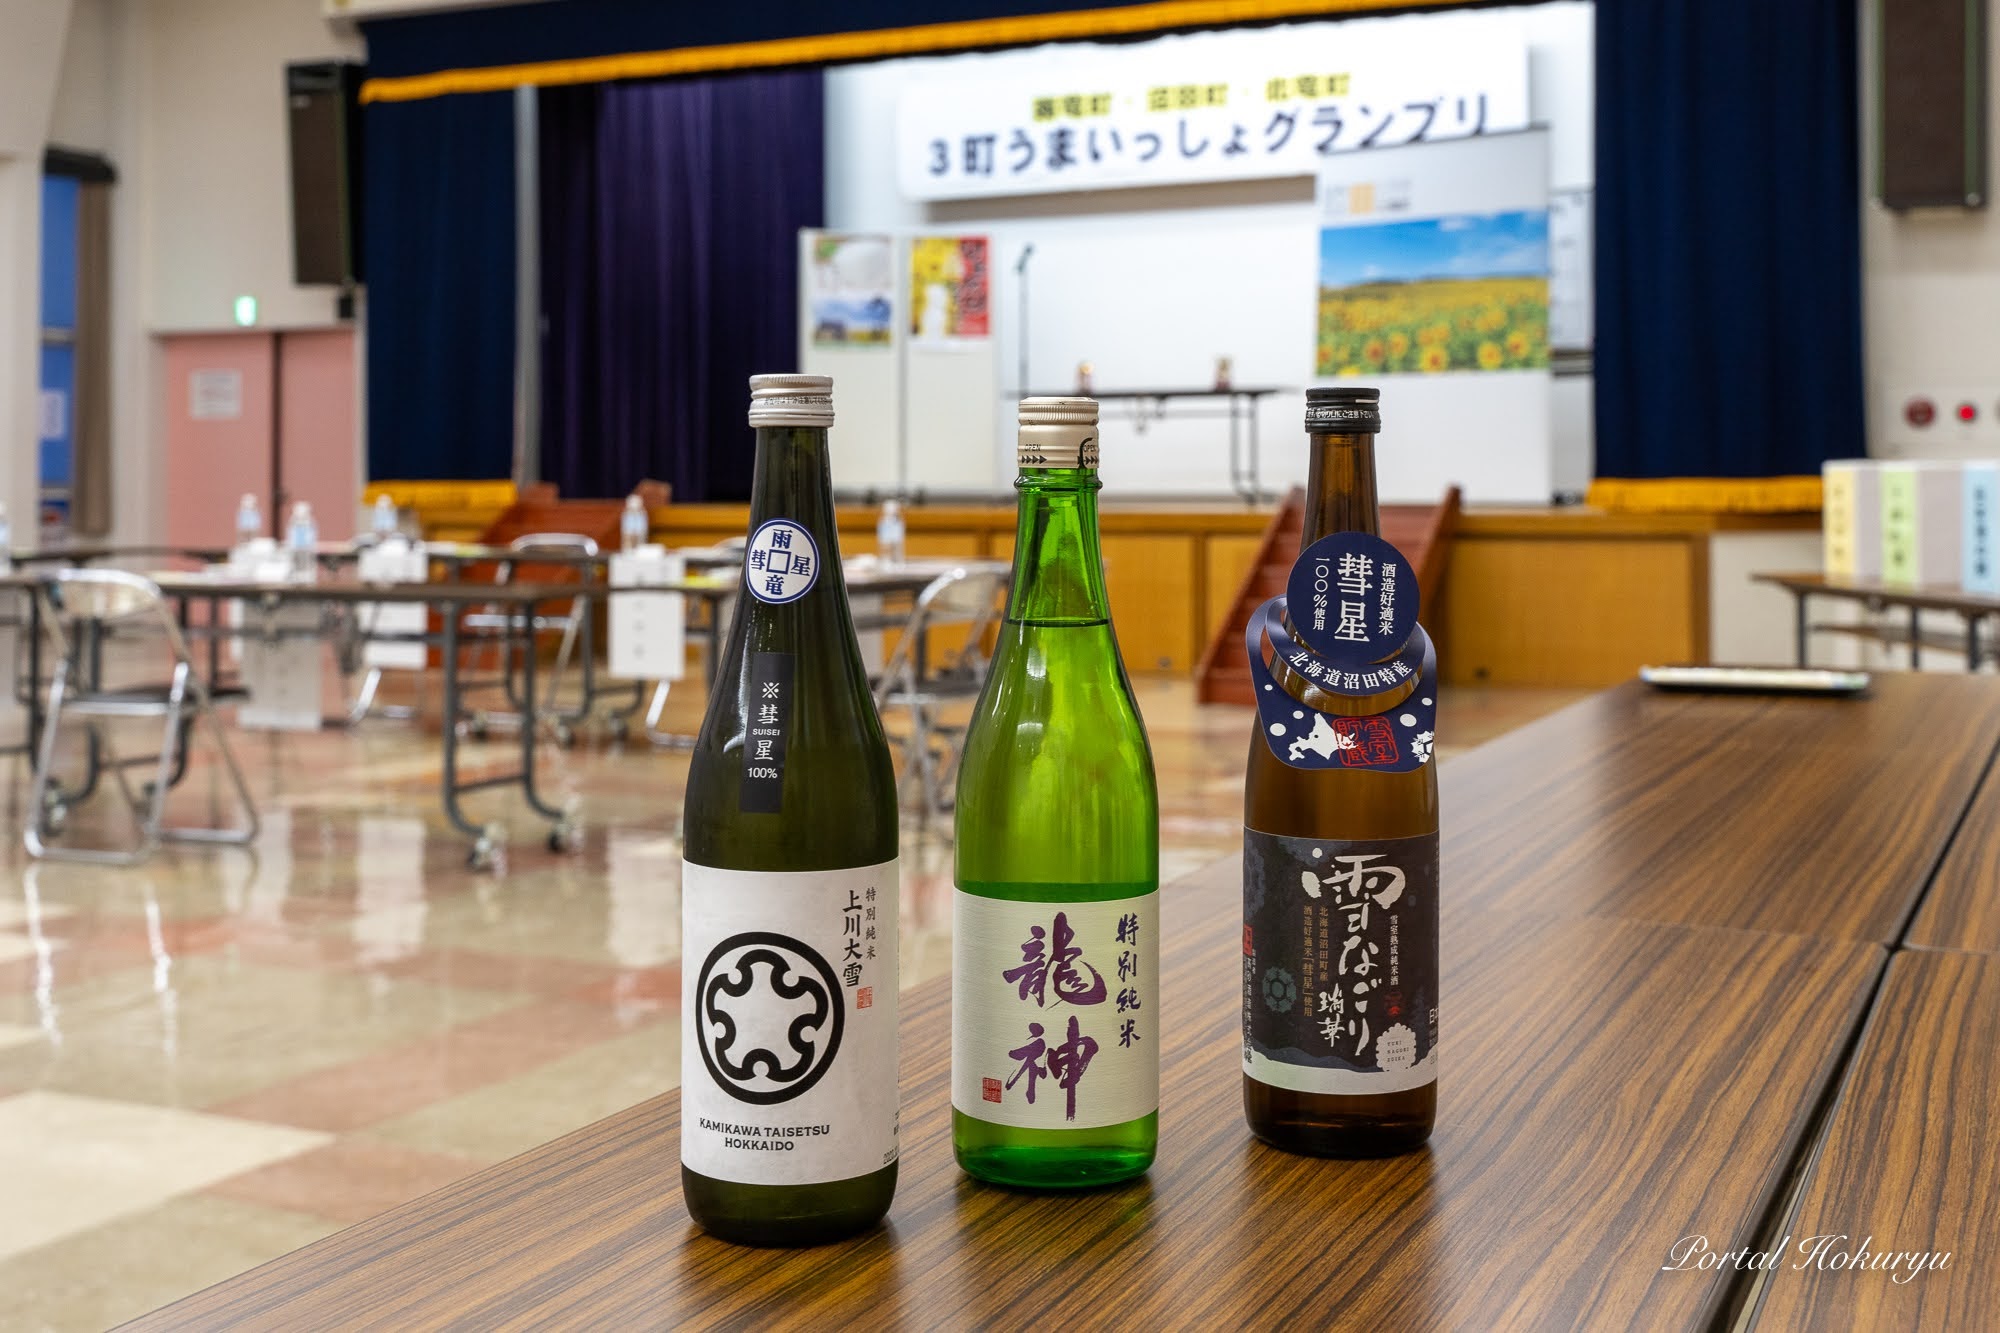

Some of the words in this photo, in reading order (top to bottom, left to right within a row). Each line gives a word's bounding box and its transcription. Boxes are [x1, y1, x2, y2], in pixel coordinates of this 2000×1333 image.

[1024, 443, 1042, 452] OPEN
[1333, 552, 1374, 642] 彗星
[1378, 562, 1397, 635] 酒造好適米
[1289, 650, 1413, 690] 北海道沼田特産
[752, 728, 781, 736] SUISEI
[747, 767, 778, 779] 100%
[842, 889, 863, 988] 上川大雪
[865, 886, 876, 960] 特別純米
[1301, 854, 1406, 1056] 雪なごり
[1002, 911, 1108, 1122] 龍神
[1115, 912, 1141, 1049] 特別純米
[699, 1117, 761, 1137] KAMIKAWA
[764, 1124, 830, 1138] TAISETSU
[725, 1137, 794, 1151] HOKKAIDO
